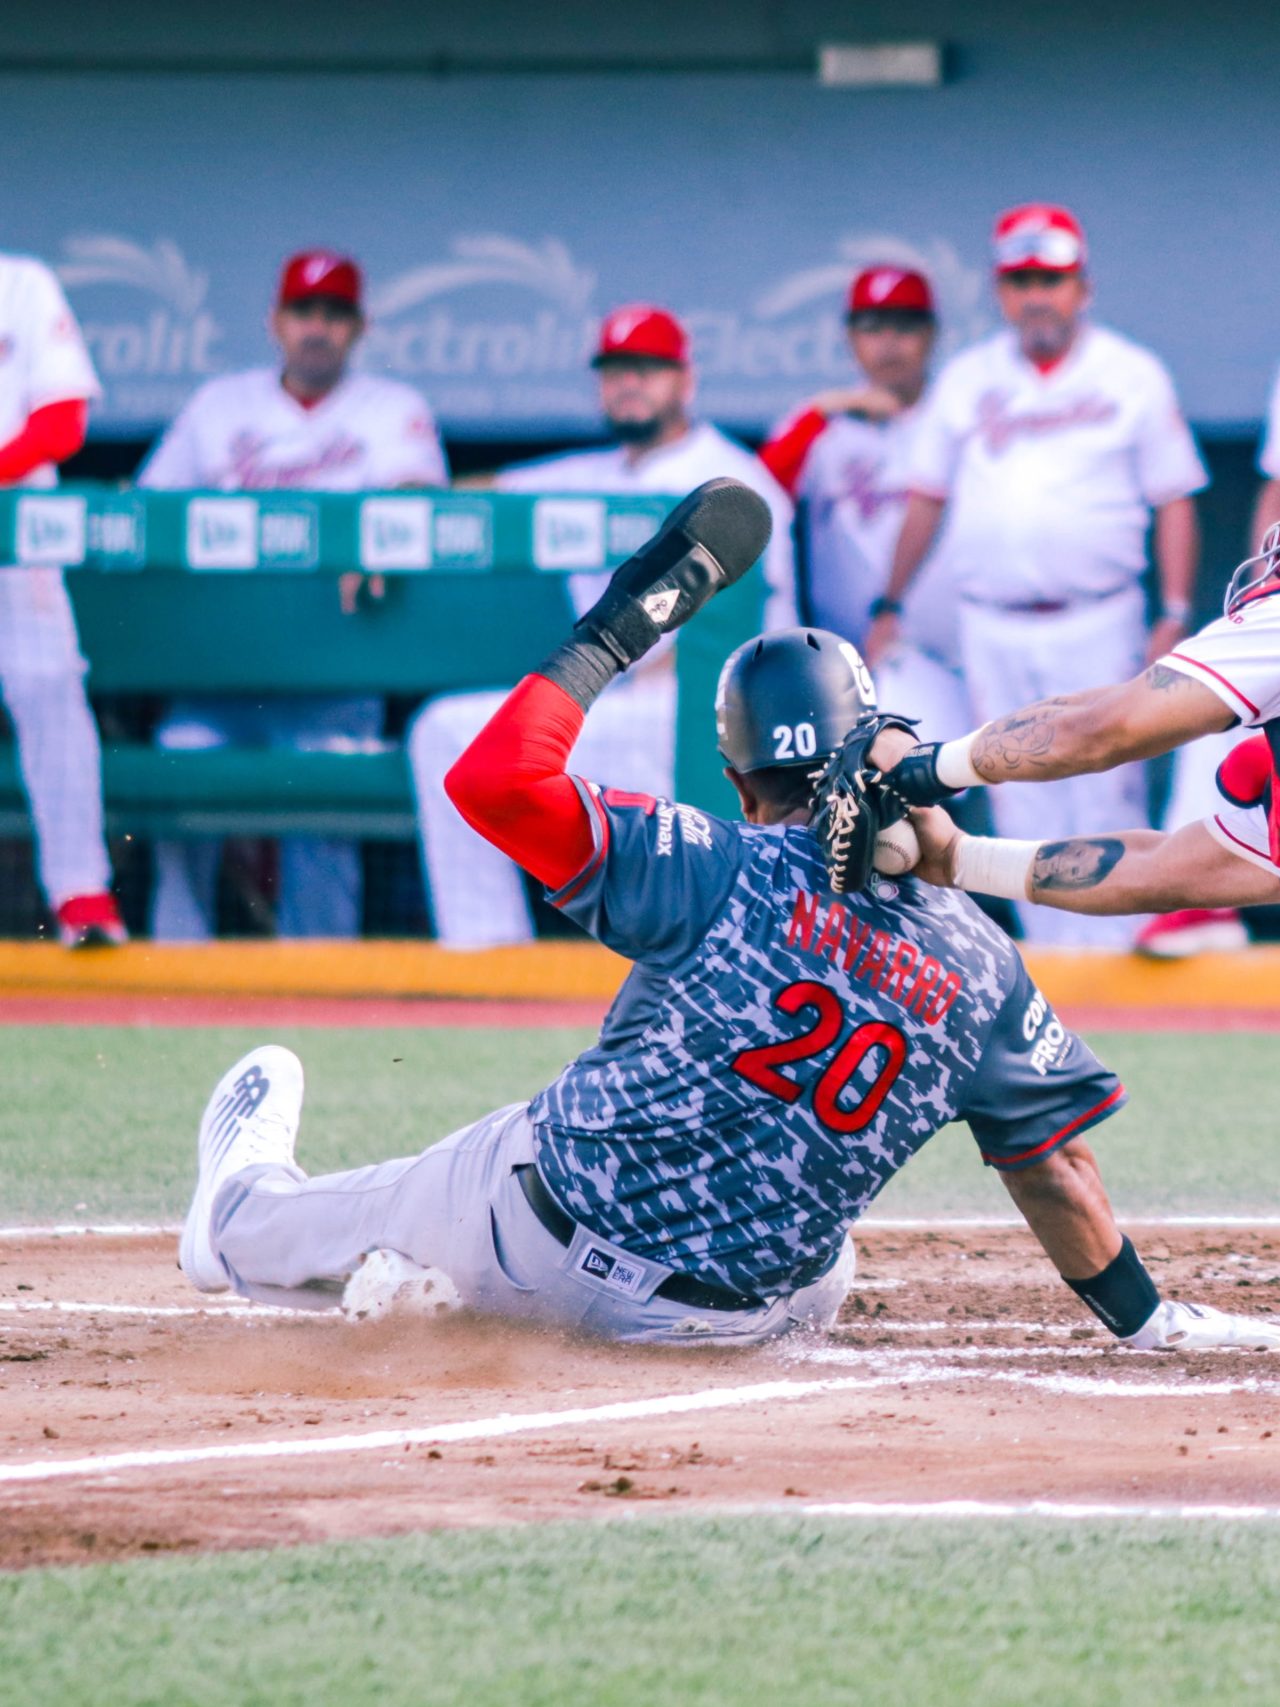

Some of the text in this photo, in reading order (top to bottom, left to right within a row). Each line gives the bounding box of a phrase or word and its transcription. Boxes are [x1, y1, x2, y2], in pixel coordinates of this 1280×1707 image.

[772, 722, 817, 760] 20
[786, 889, 962, 1027] NAVARRO
[730, 978, 908, 1134] 20
[1031, 1012, 1065, 1076] FRO
[611, 1273, 633, 1286] ERA
[616, 1265, 635, 1279] NEW
